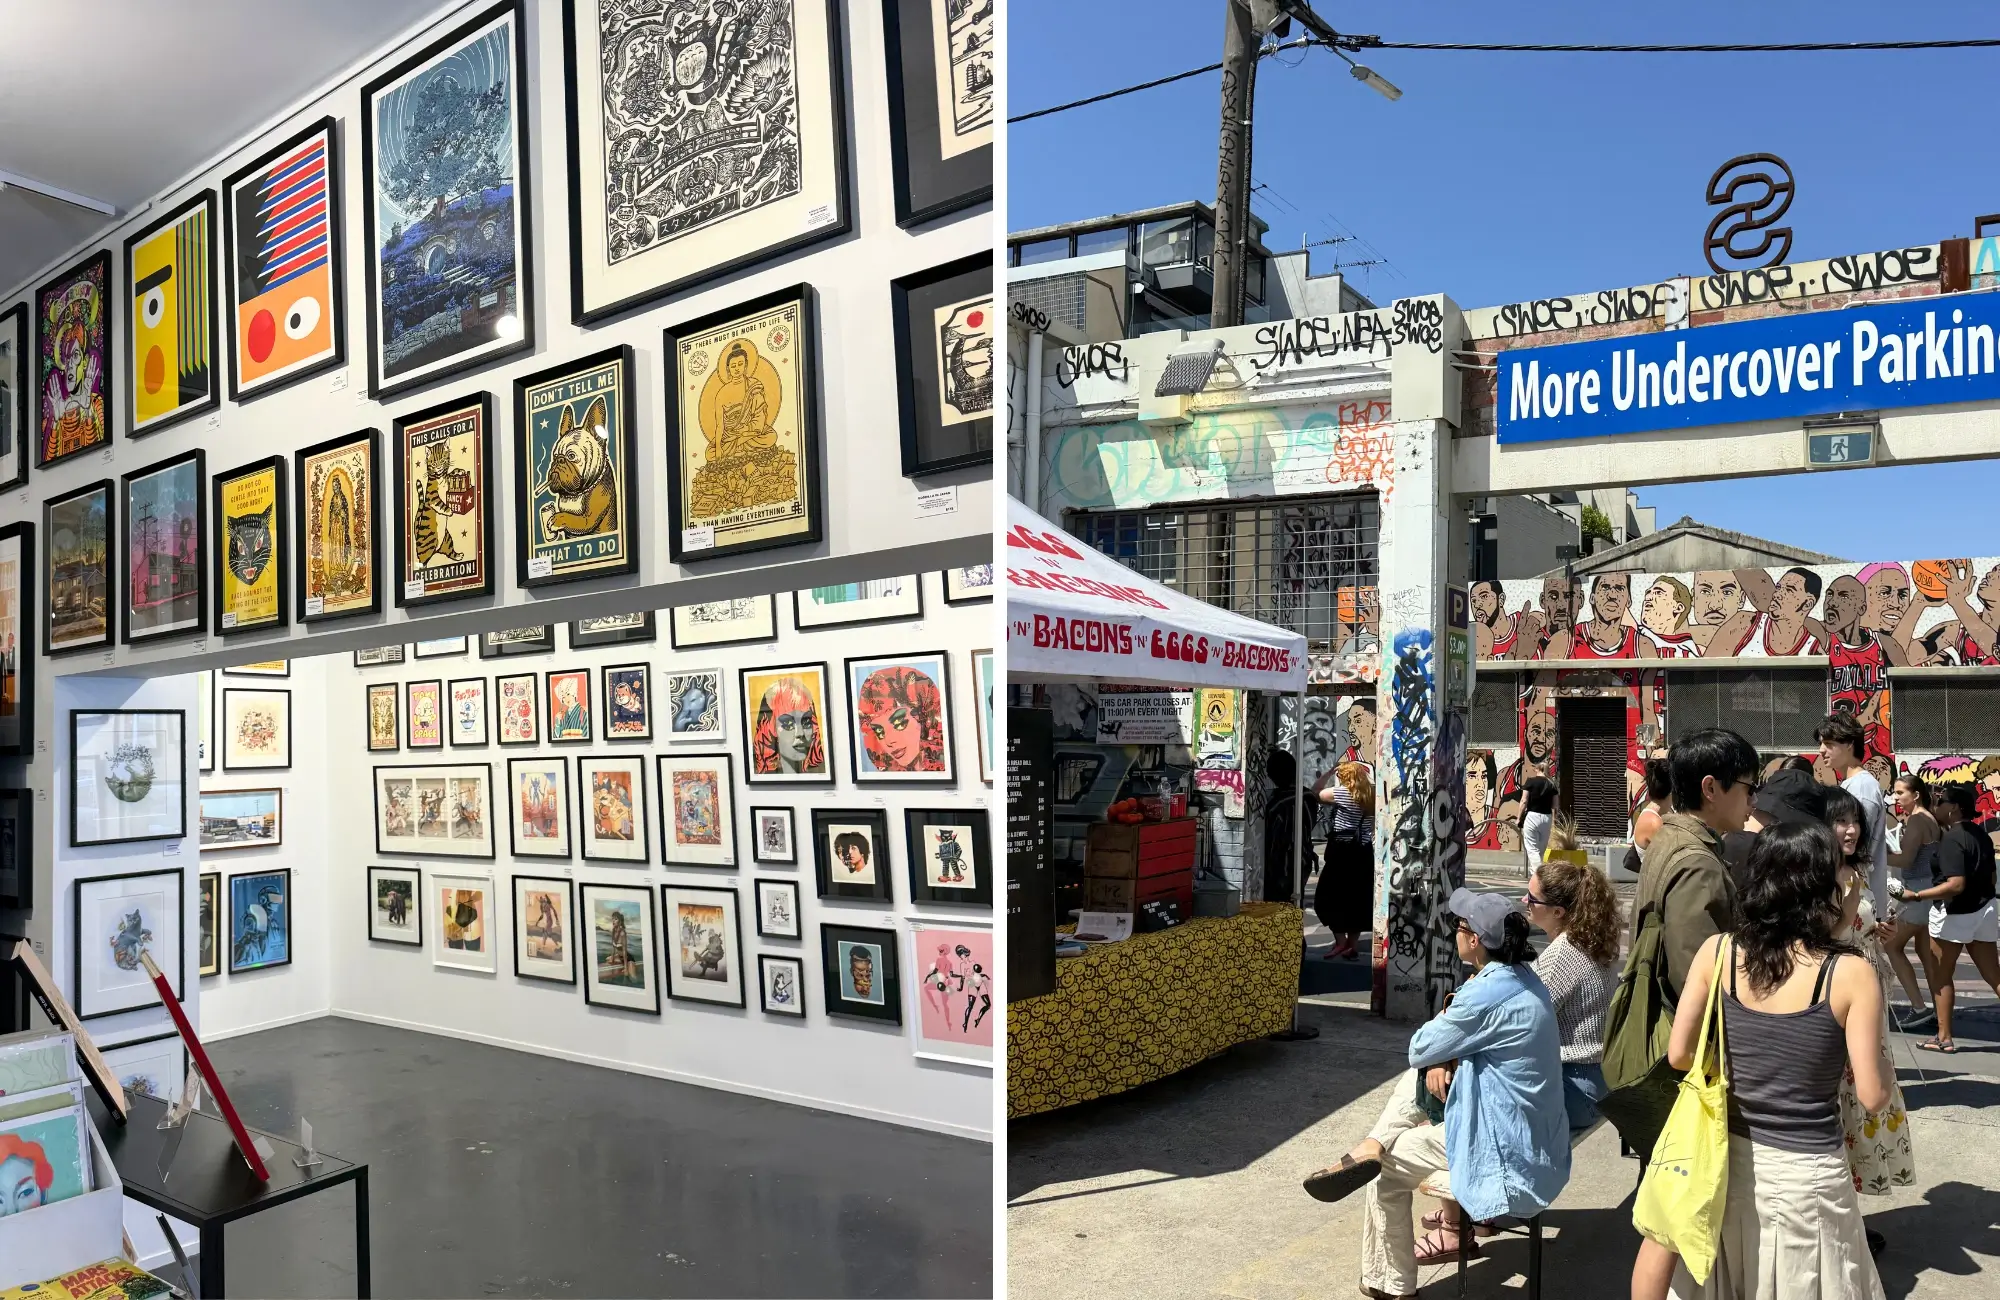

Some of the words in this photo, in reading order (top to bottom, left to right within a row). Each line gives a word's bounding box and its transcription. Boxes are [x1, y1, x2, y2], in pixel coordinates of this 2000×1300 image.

[695, 339, 712, 350] THERE
[714, 331, 730, 343] MUST
[731, 329, 739, 338] BE
[741, 325, 757, 337] MORE
[759, 321, 767, 329] TO
[768, 316, 781, 326] LIFE
[1510, 360, 1600, 421] More
[1612, 340, 1840, 411] Undercover
[1853, 309, 2000, 385] Parkin
[533, 387, 564, 407] DON'T
[568, 378, 593, 397] TELL
[597, 371, 613, 387] ME
[412, 433, 428, 446] THIS
[430, 426, 450, 441] CALLS
[453, 421, 466, 435] FOR
[469, 419, 474, 430] A
[702, 519, 719, 528] THAN
[721, 514, 744, 526] HAVING
[746, 506, 785, 519] EVERYTHING
[577, 542, 592, 557] TO
[599, 538, 616, 554] DO
[413, 565, 476, 583] CELEBRATION!
[1453, 593, 1464, 622] P
[1033, 614, 1133, 655] BACONS
[1151, 629, 1208, 664] EGGS
[1222, 640, 1290, 673] BACONS
[1101, 699, 1115, 707] THIS
[1117, 698, 1132, 707] CAR
[1134, 698, 1151, 707] PARK
[1153, 697, 1180, 707] CLOSES
[1181, 697, 1190, 706] AT
[1107, 708, 1124, 717] 11:00
[1125, 707, 1136, 716] PM
[1137, 707, 1160, 717] EVERY
[1161, 707, 1183, 716] NIGHT
[60, 1264, 109, 1289] MARS
[69, 1266, 135, 1299] ATTACKS
